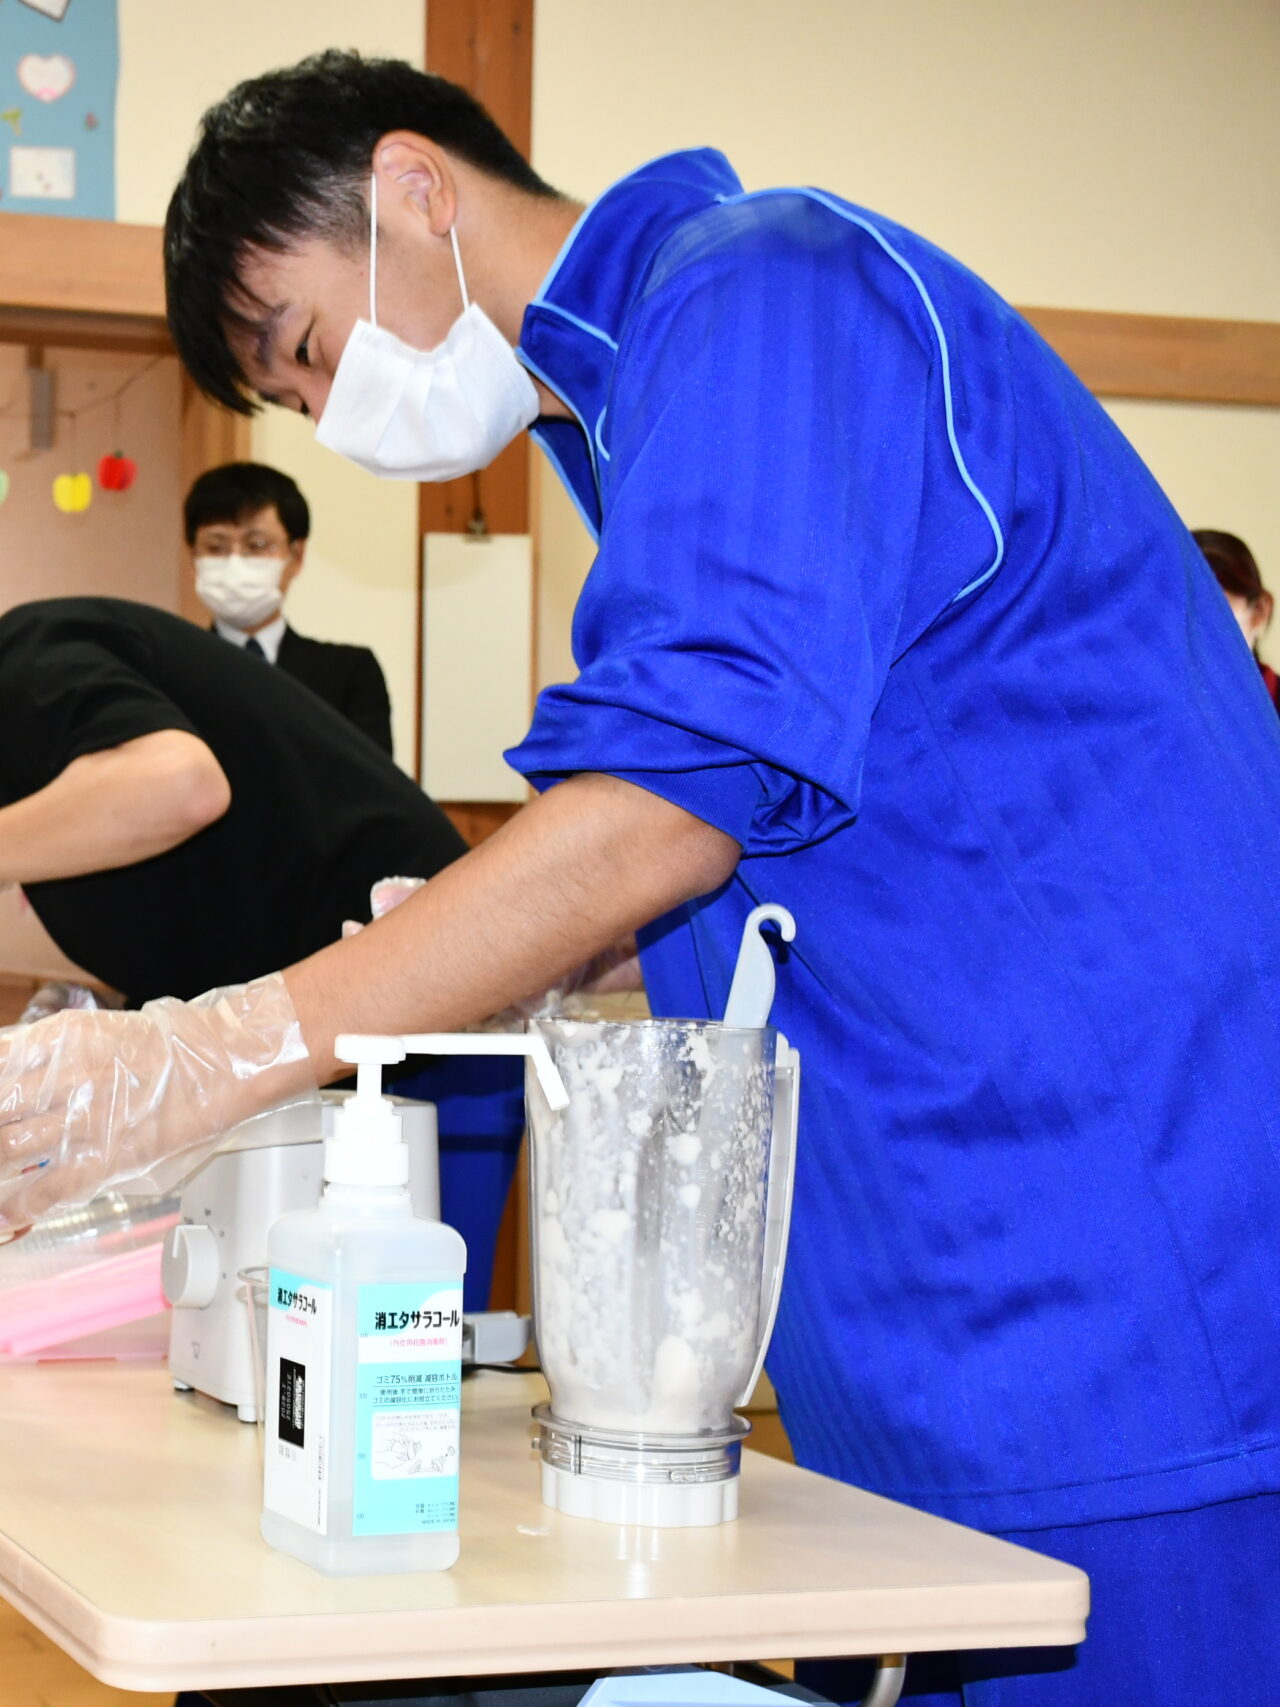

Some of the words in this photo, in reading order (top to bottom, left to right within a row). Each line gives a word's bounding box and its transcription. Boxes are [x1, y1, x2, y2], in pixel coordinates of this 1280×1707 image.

[374, 1309, 460, 1331] 消エタサラコール
